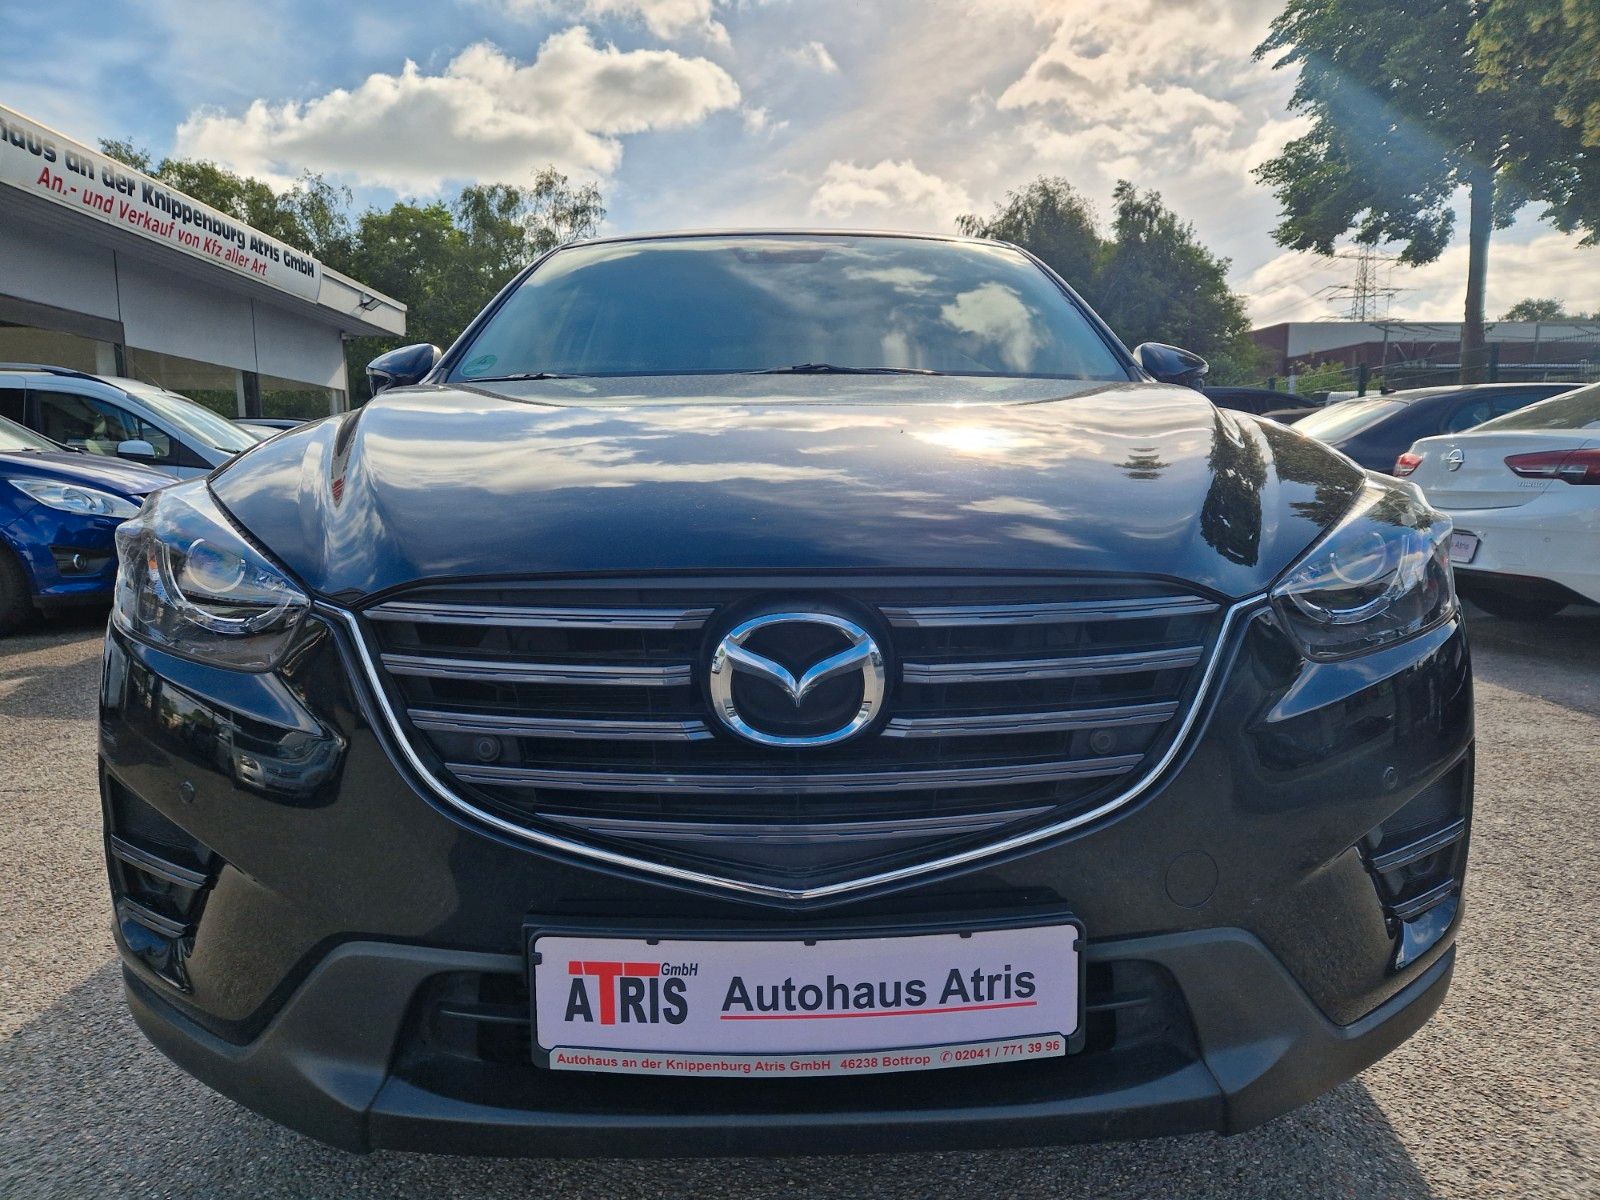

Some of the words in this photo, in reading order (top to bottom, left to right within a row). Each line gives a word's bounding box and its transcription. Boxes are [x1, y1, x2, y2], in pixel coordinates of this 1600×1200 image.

[65, 149, 95, 180] an
[102, 163, 136, 197] der
[142, 181, 246, 250] Knippenburg
[249, 233, 280, 263] Atris
[283, 249, 316, 278] GmbH
[82, 188, 115, 214] und
[119, 200, 176, 239] Verkauf
[178, 228, 201, 249] von
[203, 236, 223, 258] Kfz
[224, 247, 250, 268] aller
[250, 258, 268, 276] Art
[564, 961, 689, 1025] ATRIS
[660, 962, 699, 977] GmbH
[721, 975, 927, 1012] Autohaus
[939, 964, 1036, 1005] Atris
[556, 1053, 619, 1068] Autohaus
[621, 1058, 638, 1068] an
[642, 1057, 662, 1070] der
[666, 1059, 752, 1074] Knippenburg
[754, 1059, 786, 1072] Atris
[789, 1059, 831, 1071] GmbH
[840, 1057, 878, 1070] 46238
[882, 1053, 931, 1069] Bottrop
[954, 1047, 991, 1061] 02041
[1003, 1044, 1023, 1056] 771
[1027, 1042, 1042, 1053] 39
[1045, 1040, 1060, 1051] 96
